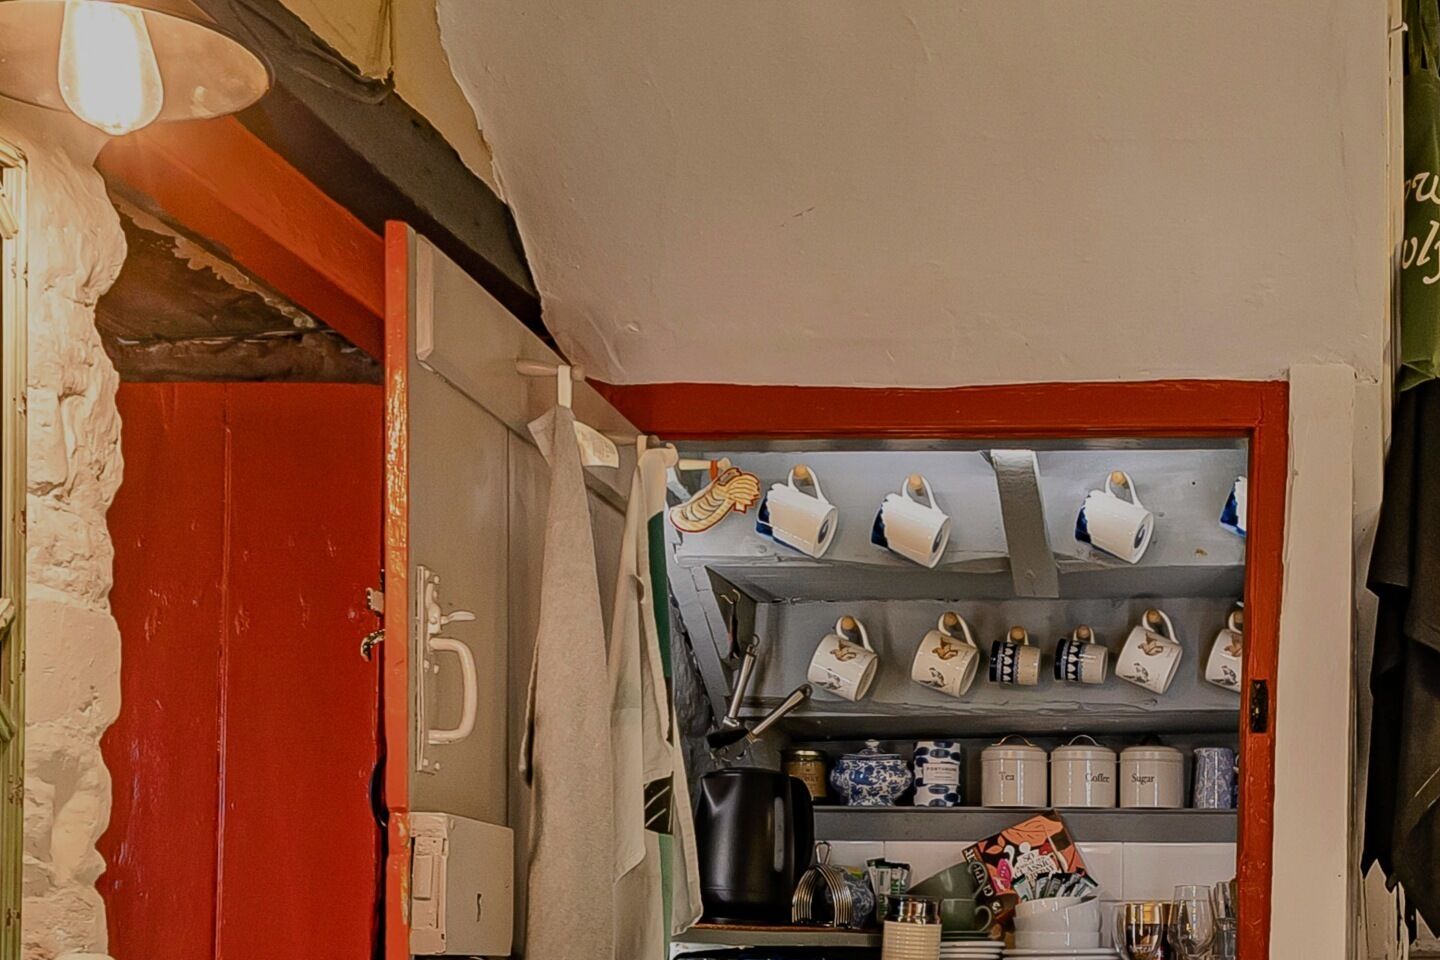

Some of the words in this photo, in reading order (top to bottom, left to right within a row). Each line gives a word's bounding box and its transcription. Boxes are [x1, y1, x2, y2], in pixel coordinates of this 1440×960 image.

[998, 771, 1015, 782] Tea
[1085, 772, 1111, 784] Coffee
[1131, 773, 1155, 785] Sugar
